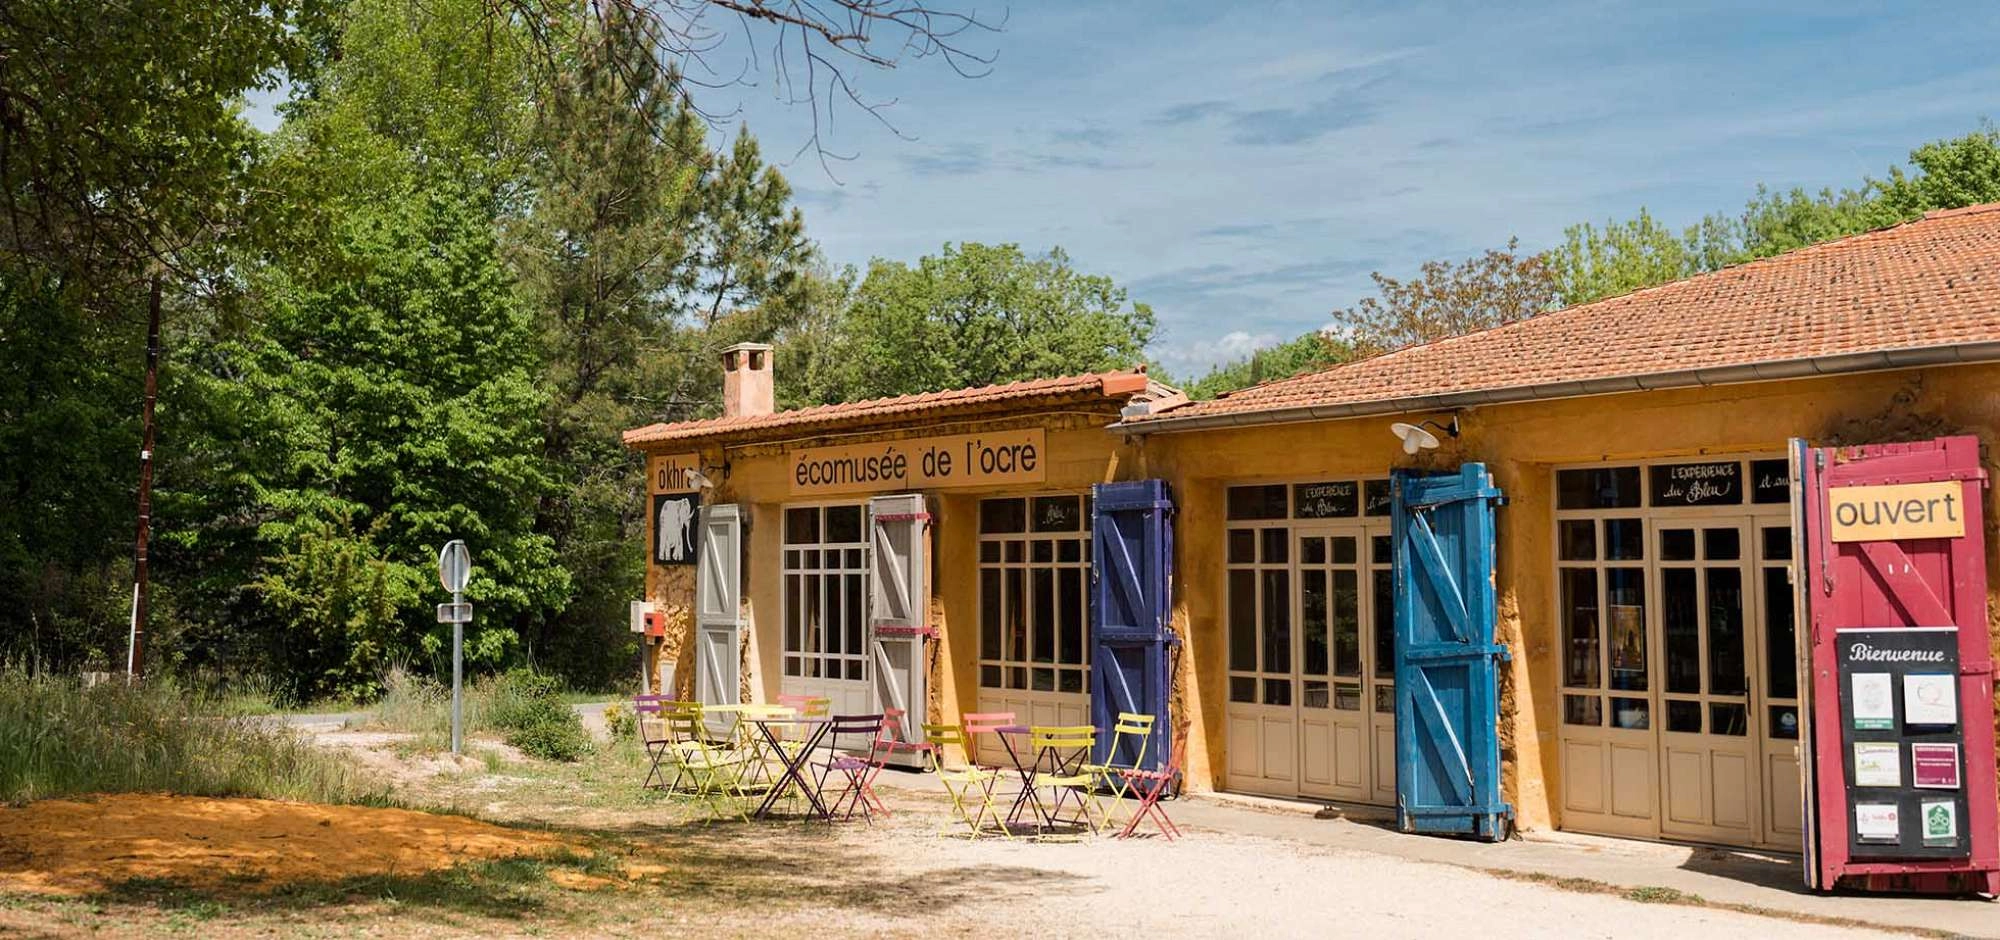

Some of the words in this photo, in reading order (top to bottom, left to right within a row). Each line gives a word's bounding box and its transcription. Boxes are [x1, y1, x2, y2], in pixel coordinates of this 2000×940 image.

[796, 447, 907, 486] écomusée
[922, 446, 952, 477] de
[1664, 484, 1683, 498] du
[1836, 494, 1957, 527] ouvert
[1849, 643, 1945, 662] Bienvenue
